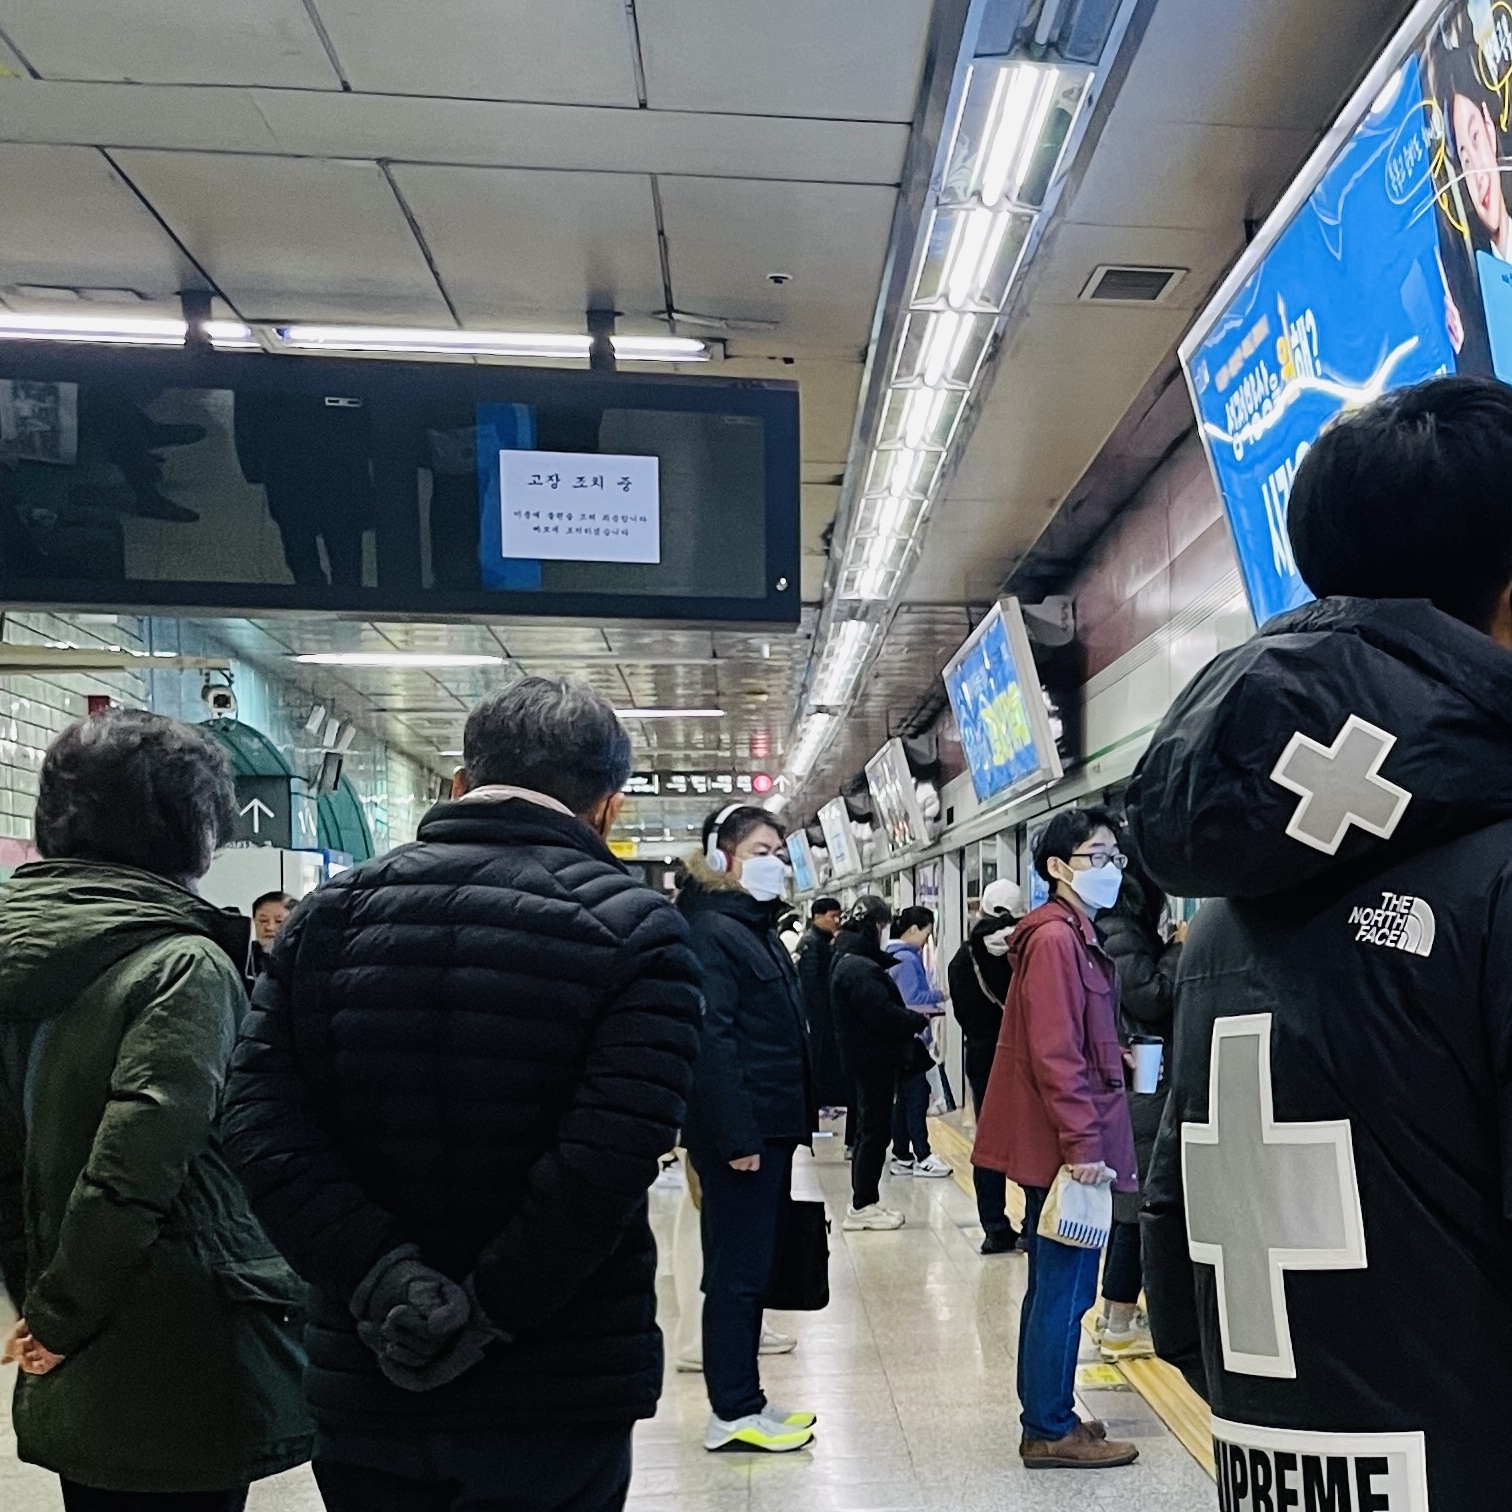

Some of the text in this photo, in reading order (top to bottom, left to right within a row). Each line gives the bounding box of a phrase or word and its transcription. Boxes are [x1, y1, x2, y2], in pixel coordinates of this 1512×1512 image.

[528, 473, 632, 492] 고장 조치 중
[1381, 892, 1414, 914] THE
[1347, 906, 1409, 931] NORTH
[1354, 925, 1401, 948] FACE
